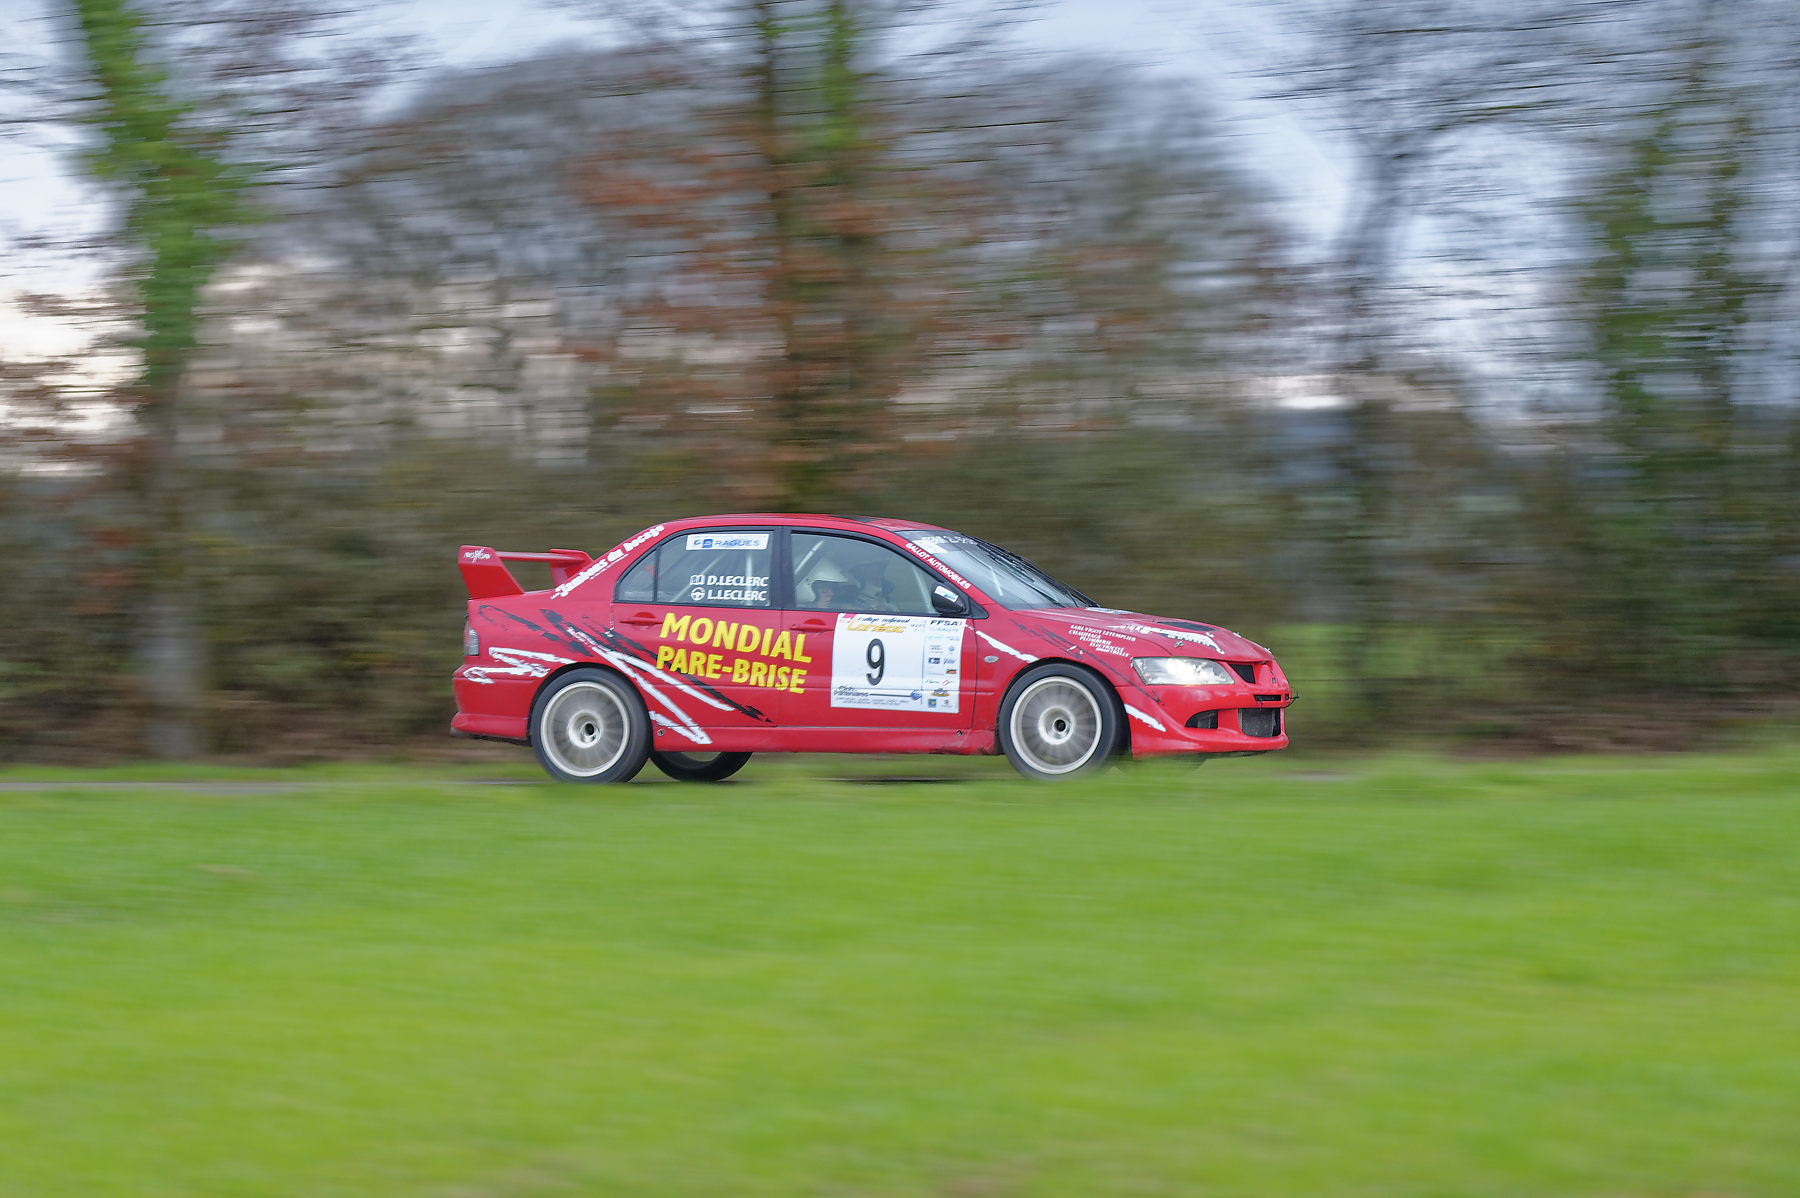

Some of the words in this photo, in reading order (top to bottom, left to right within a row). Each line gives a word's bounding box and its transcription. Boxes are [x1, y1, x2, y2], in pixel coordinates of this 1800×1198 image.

[707, 575, 769, 587] D.LECLERC
[926, 557, 972, 590] AUTOMOBILES
[707, 589, 767, 601] L.LECLERC
[659, 612, 813, 664] MONDIAL
[656, 645, 808, 694] PARE-BRISE
[866, 638, 885, 686] 9
